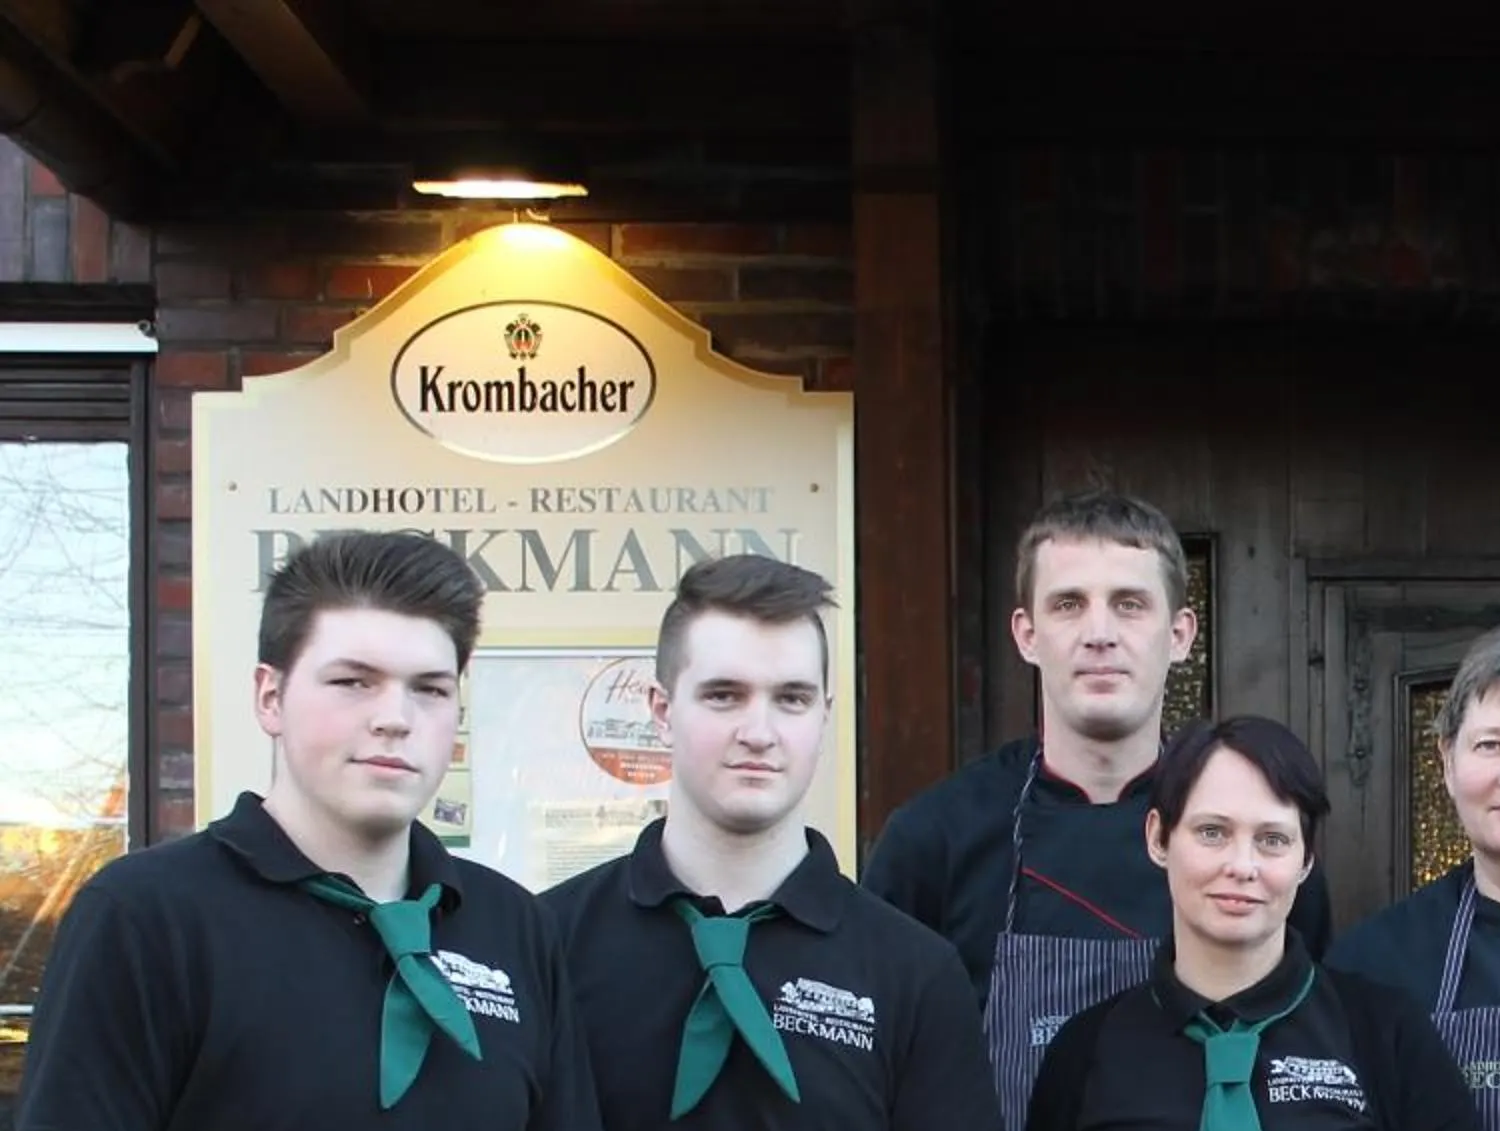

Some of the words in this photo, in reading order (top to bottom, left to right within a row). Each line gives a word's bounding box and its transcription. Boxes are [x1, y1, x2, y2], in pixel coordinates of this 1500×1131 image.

[419, 366, 635, 413] Krombacher
[269, 486, 498, 515] LANDHOTEL
[530, 486, 776, 515] RESTAURANT
[773, 1013, 874, 1052] BECKMANN
